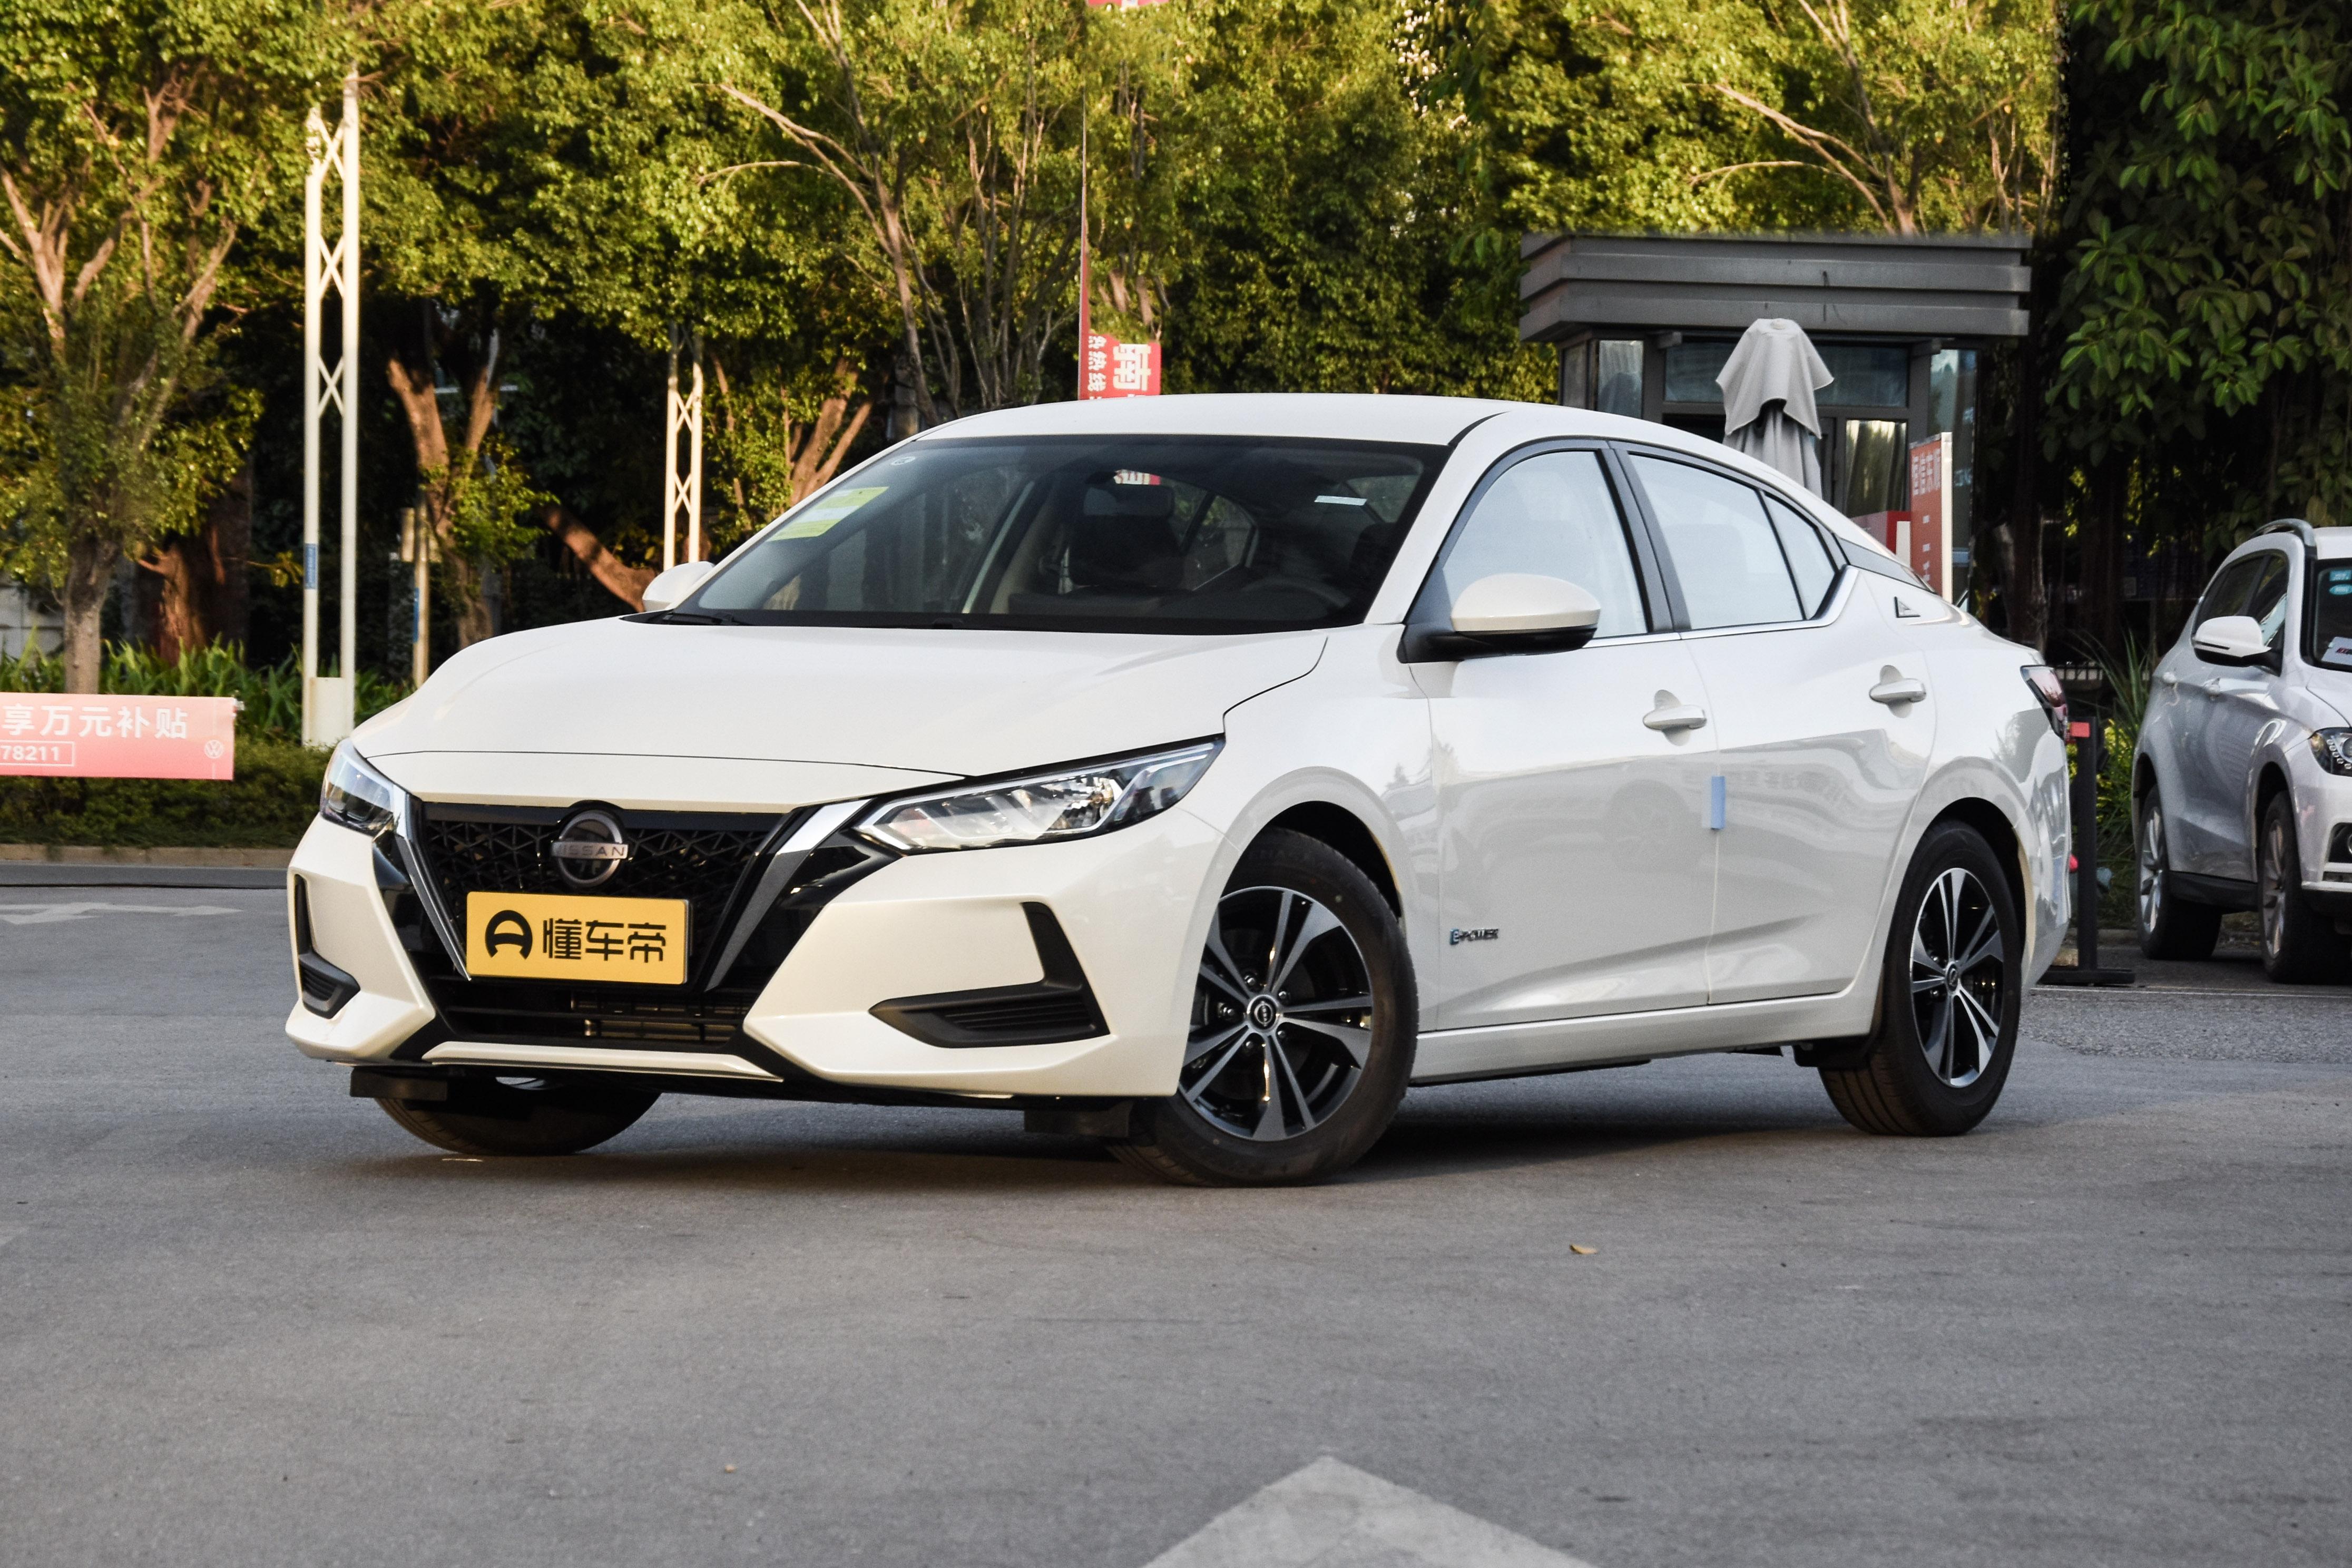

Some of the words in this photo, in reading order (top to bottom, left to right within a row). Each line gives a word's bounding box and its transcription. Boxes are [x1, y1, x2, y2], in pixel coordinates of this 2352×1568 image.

[2, 703, 188, 739] 享万元补贴
[0, 745, 60, 761] 78211
[556, 844, 625, 858] ISSAN
[543, 918, 667, 963] 懂车帝
